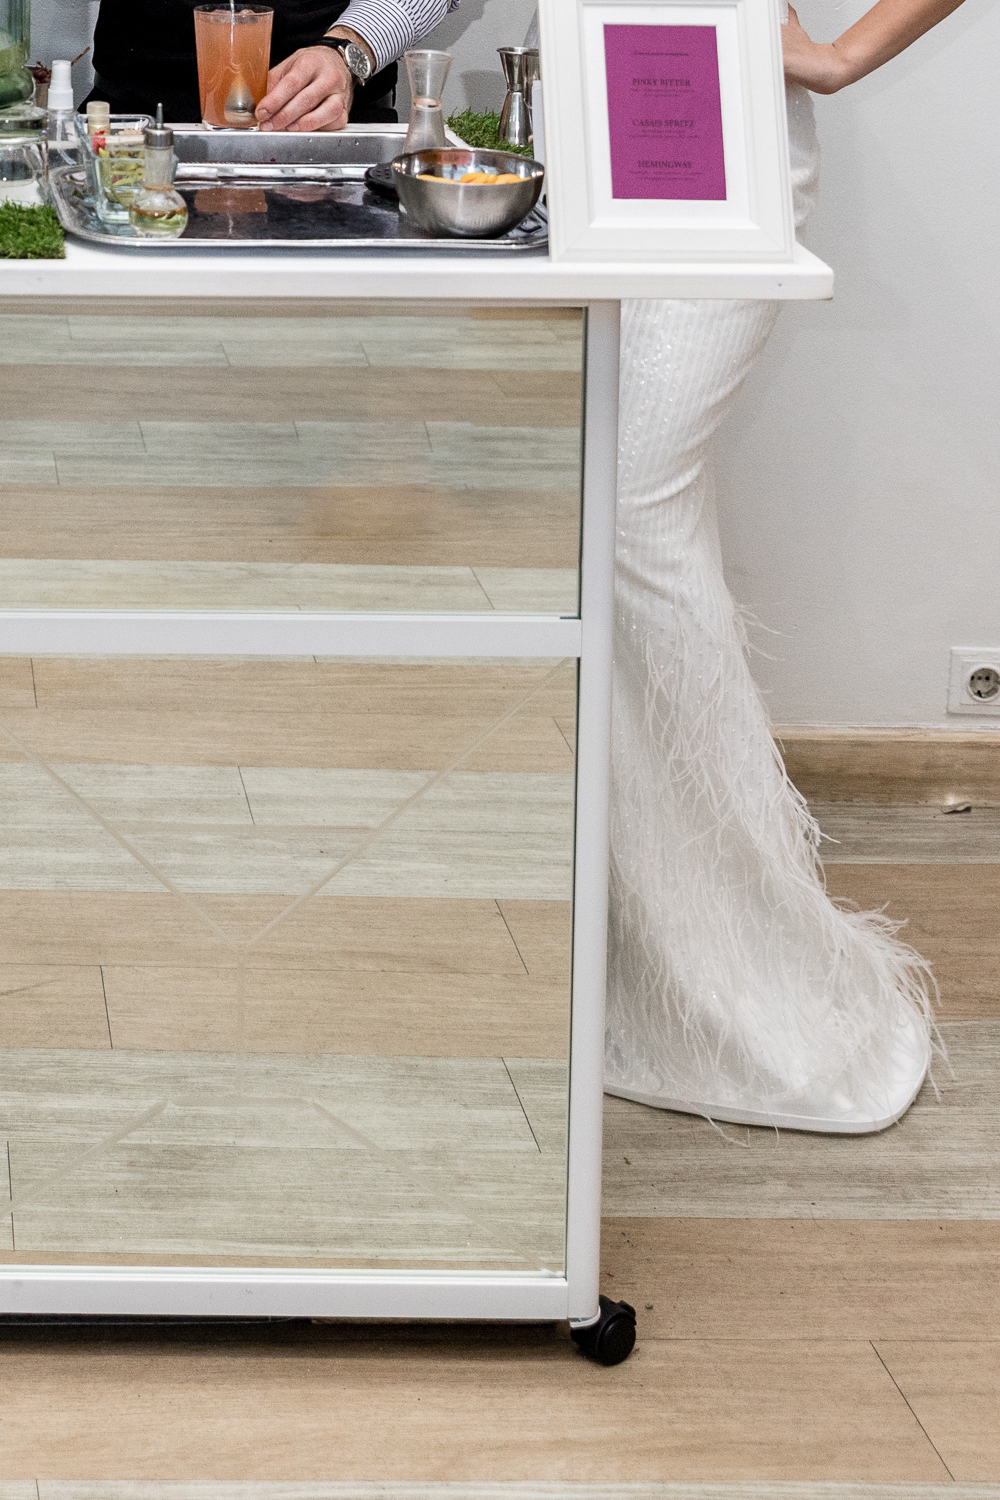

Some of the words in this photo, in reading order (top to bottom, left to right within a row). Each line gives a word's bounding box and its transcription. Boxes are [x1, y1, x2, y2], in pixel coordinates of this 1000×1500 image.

[632, 78, 657, 86] PINKY
[660, 79, 691, 87] BITTER
[664, 119, 694, 128] SPRITZ
[637, 160, 692, 168] HEMINGWAY
